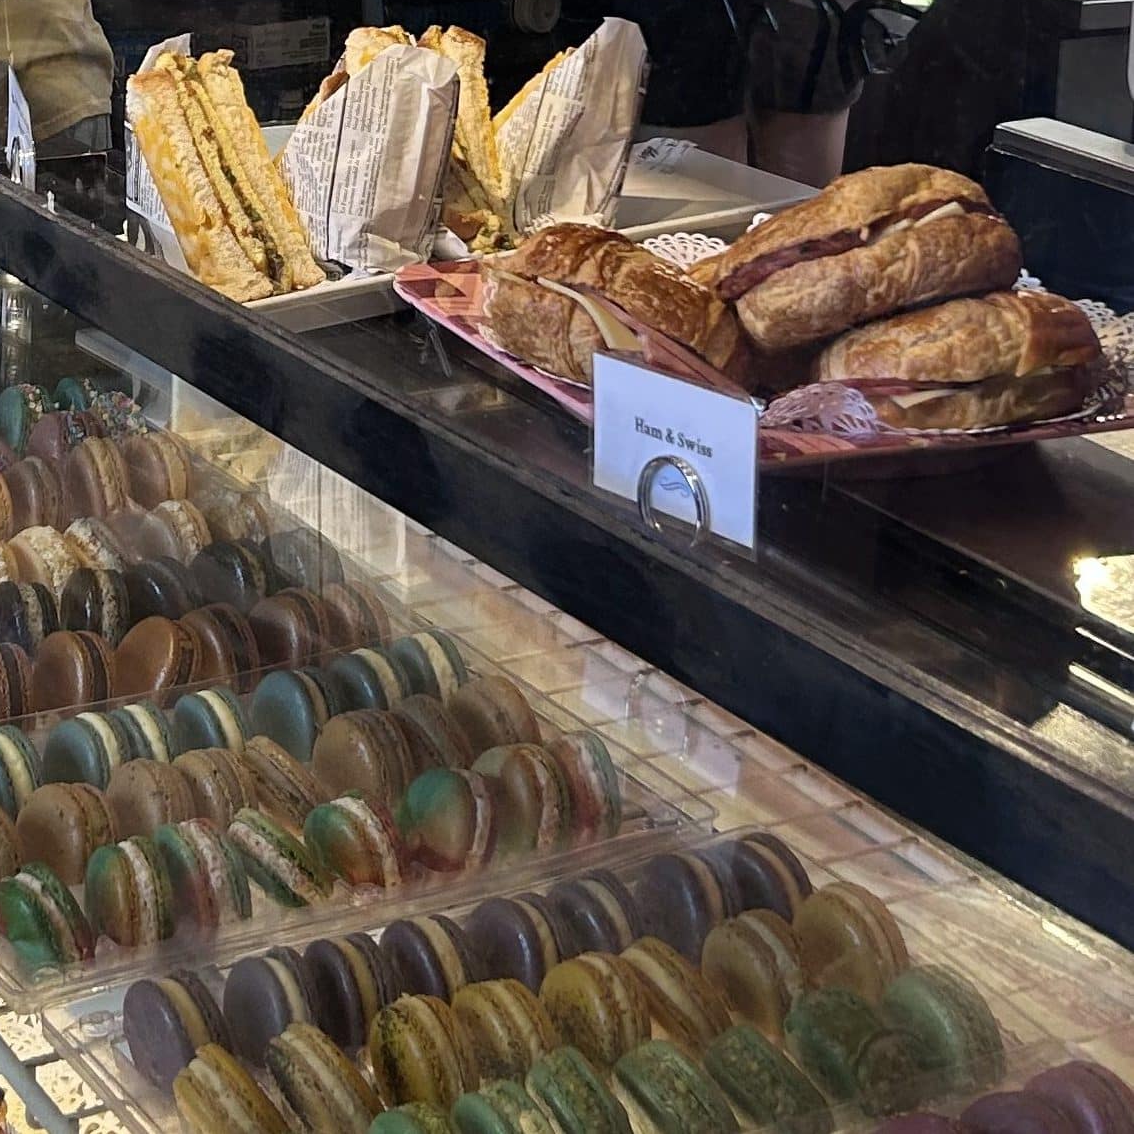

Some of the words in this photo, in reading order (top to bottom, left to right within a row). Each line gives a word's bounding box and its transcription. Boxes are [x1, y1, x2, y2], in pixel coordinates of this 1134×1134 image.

[634, 416, 663, 442] Ham
[666, 428, 675, 444] &
[677, 432, 714, 458] Swiss
